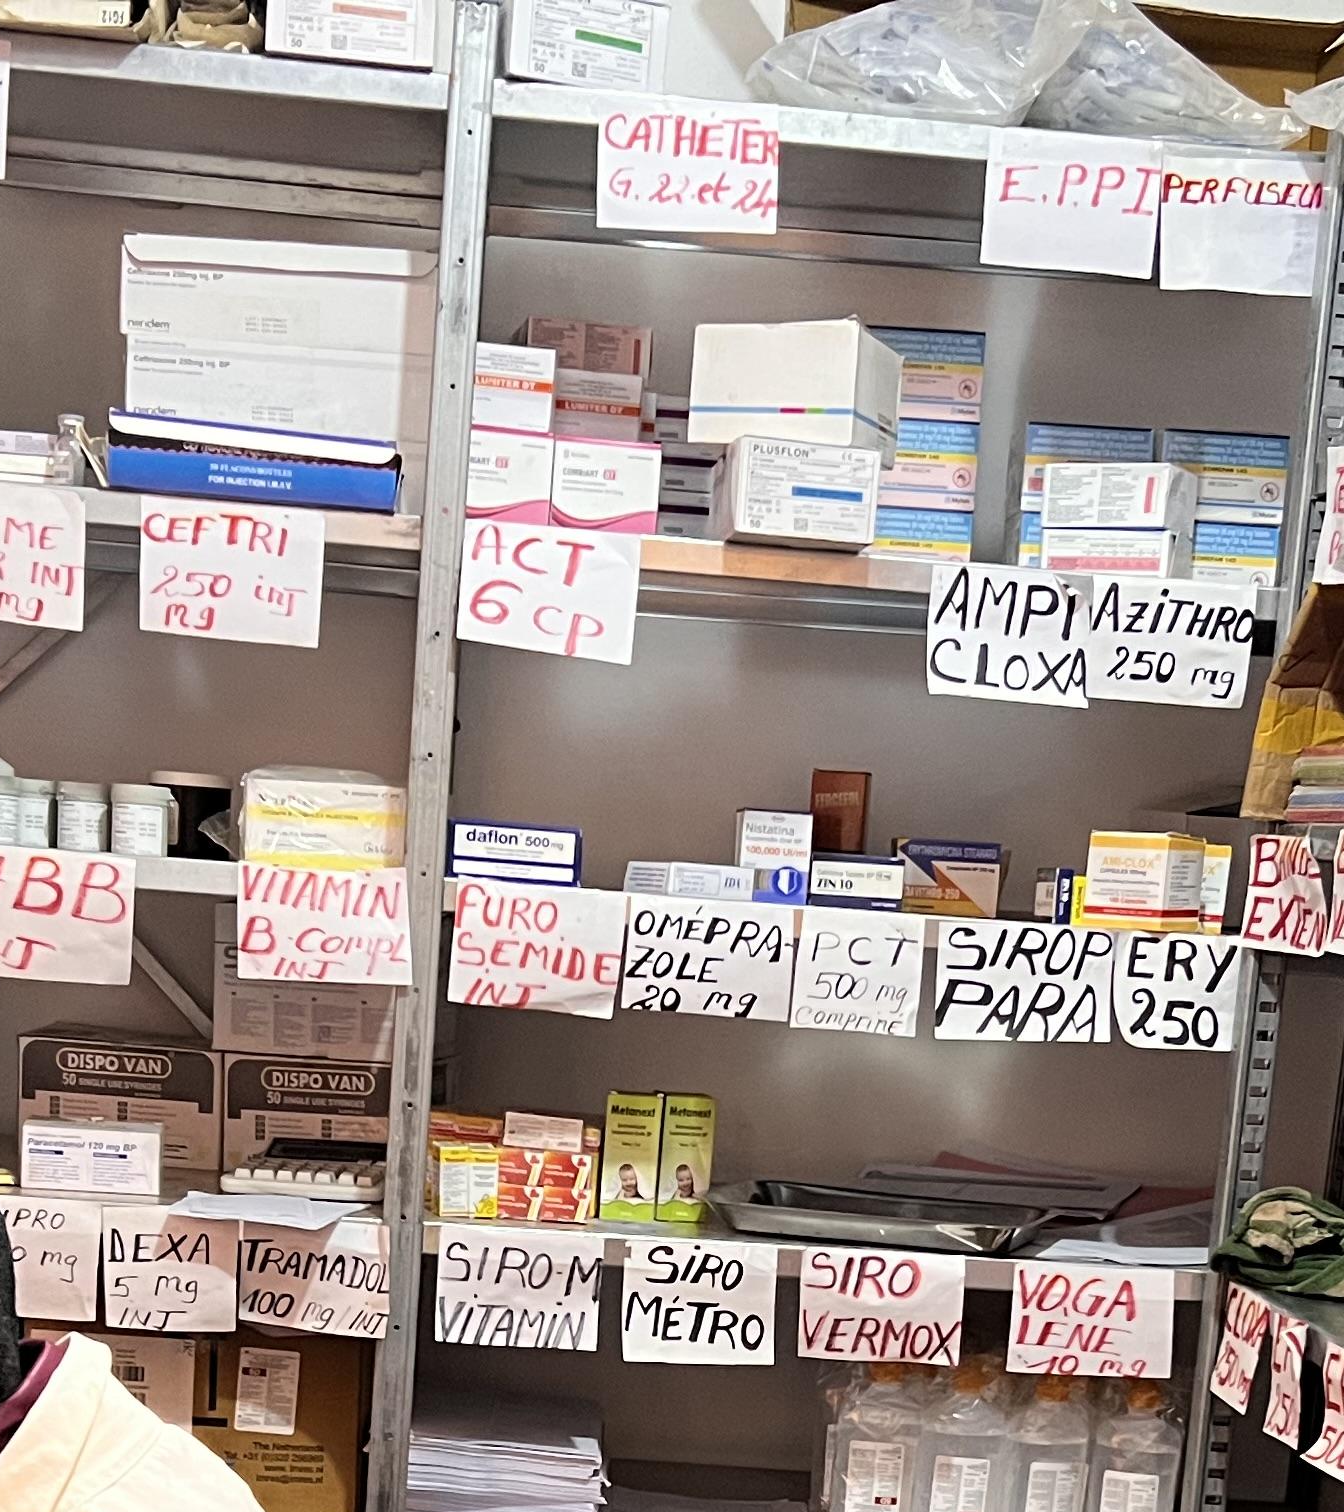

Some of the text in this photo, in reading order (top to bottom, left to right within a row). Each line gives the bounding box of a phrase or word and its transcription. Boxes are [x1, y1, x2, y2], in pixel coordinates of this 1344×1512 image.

[604, 114, 779, 164] CATHETER
[697, 173, 730, 205] et
[753, 443, 810, 459] PLUSFLON
[143, 512, 289, 557] CEFTRI
[471, 525, 595, 588] ACT
[151, 565, 233, 599] 250
[469, 579, 523, 625] 6
[934, 567, 1079, 641] AMPI
[1091, 582, 1255, 643] AZITHRO
[929, 638, 1088, 697] CLOXA
[1107, 646, 1235, 699] 250 mg
[466, 827, 519, 848] daflon
[525, 835, 550, 849] 500
[745, 821, 795, 836] Nistatina
[241, 863, 401, 920] VITAMIN
[839, 880, 853, 890] 10
[456, 883, 558, 933] FURO
[1242, 894, 1326, 952] EXTEN
[625, 944, 725, 984] ZOLE
[811, 930, 919, 968] PCT
[946, 927, 1113, 981] SIROP
[1126, 936, 1238, 993] ERY
[703, 990, 759, 1018] mg
[806, 971, 909, 1014] 500 mg
[934, 979, 1097, 1043] PARA
[1130, 989, 1219, 1048] 250
[62, 1073, 76, 1086] 50
[67, 1052, 162, 1076] DISPO VAN
[272, 1070, 365, 1092] DISPO VAN
[266, 1091, 281, 1104] 50
[88, 1140, 104, 1150] 120
[106, 1142, 121, 1152] mg
[40, 1251, 78, 1283] mg
[108, 1228, 211, 1265] DEXA
[241, 1238, 390, 1294] TRAMADOL
[645, 1245, 744, 1291] SIRO
[109, 1274, 199, 1304] 5 mg
[805, 1252, 922, 1299] SIRO
[118, 1306, 187, 1331] INJ
[242, 1288, 295, 1318] 100
[439, 1293, 586, 1350] VITAMIN
[802, 1309, 962, 1368] VERMOX
[1016, 1315, 1132, 1357] LENE
